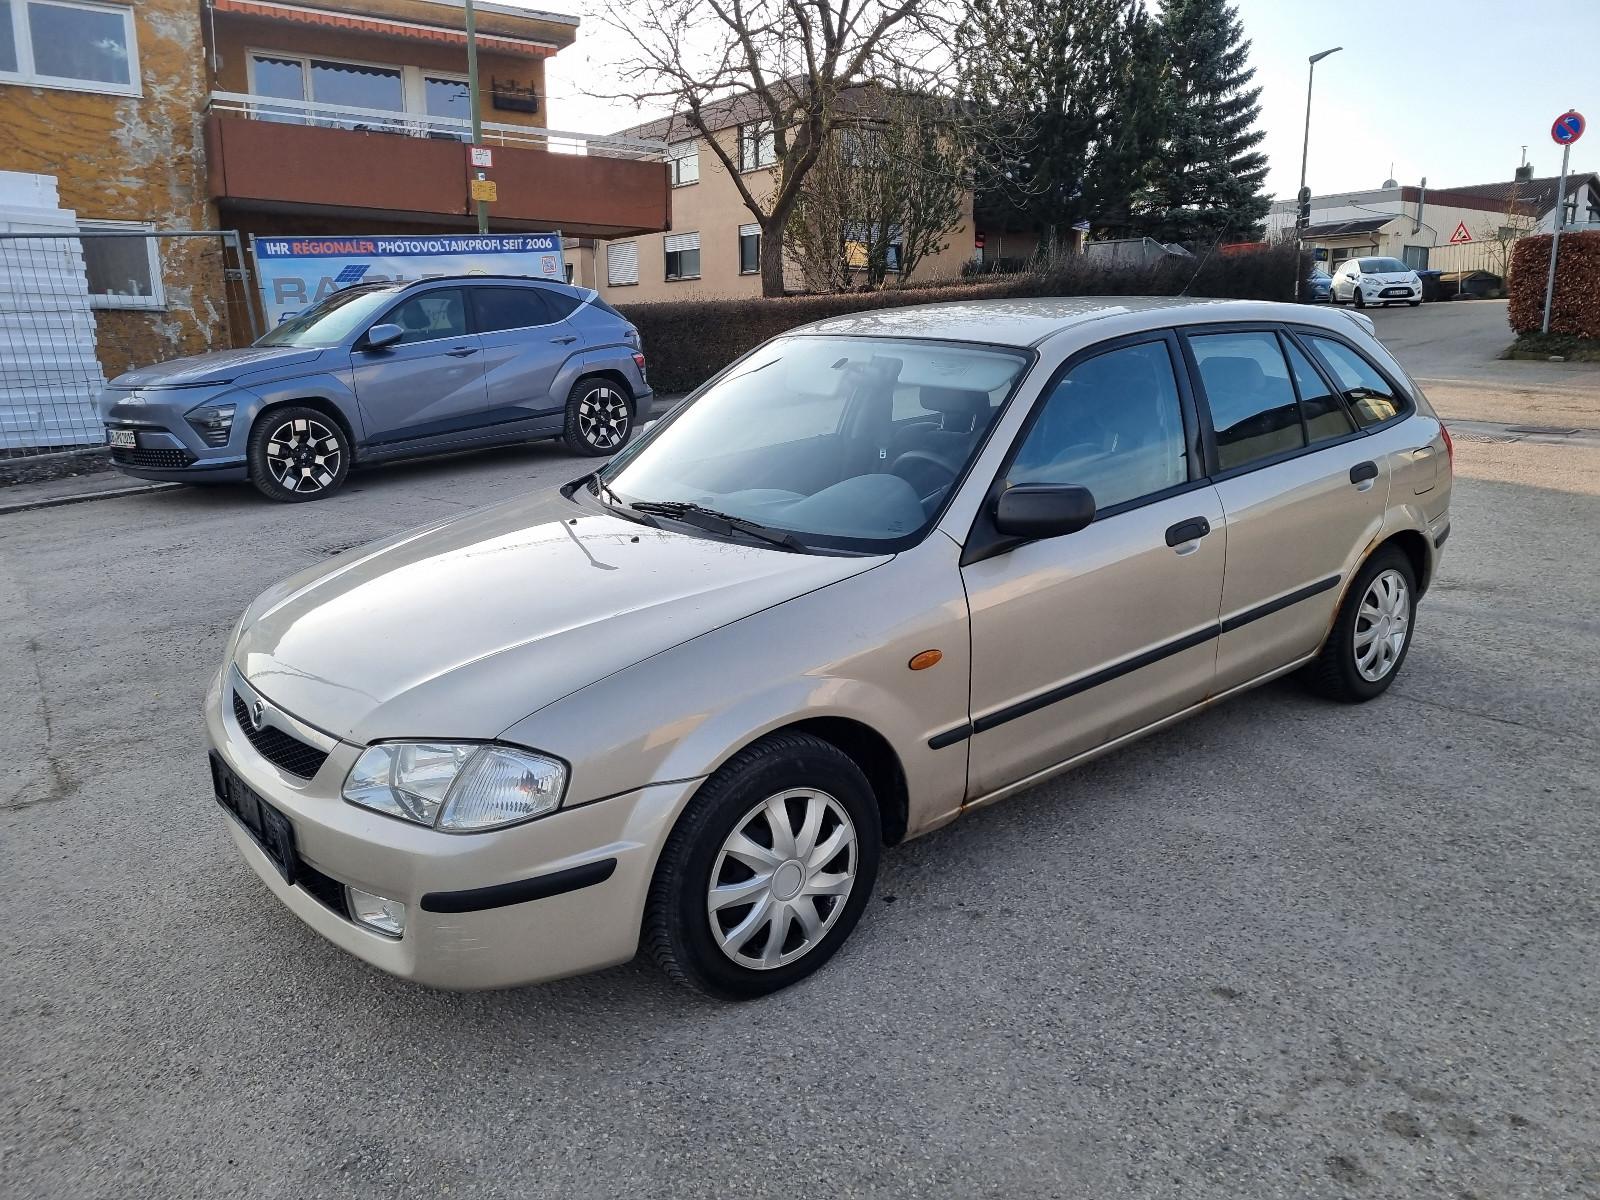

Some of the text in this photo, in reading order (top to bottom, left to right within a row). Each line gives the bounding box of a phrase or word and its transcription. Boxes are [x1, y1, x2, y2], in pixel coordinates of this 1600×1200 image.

[265, 238, 553, 255] IHR REGIONALER PHOTOVOLTAIKPROFI SEIT 2006
